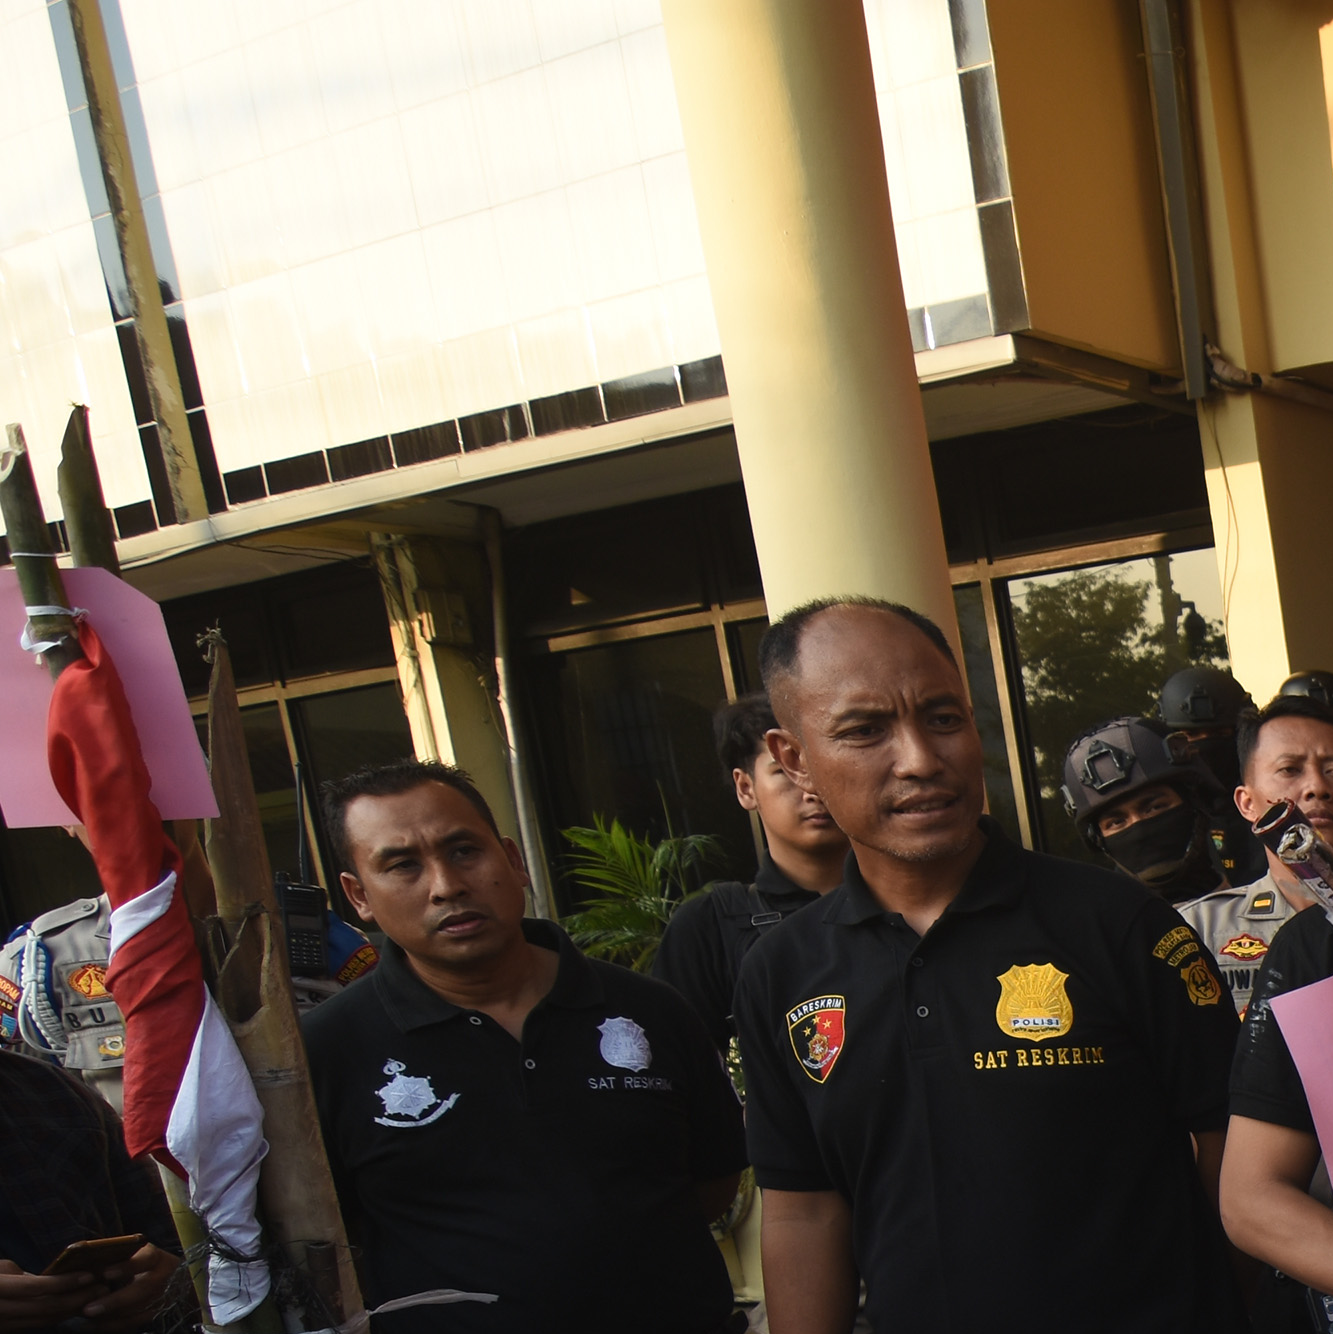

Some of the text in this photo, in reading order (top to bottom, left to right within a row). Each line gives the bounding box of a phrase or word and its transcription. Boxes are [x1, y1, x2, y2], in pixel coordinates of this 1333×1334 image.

[790, 998, 842, 1022] BARESKRIM
[1012, 1018, 1060, 1026] POLISI
[974, 1046, 1104, 1070] SAT RESKRIM
[588, 1077, 616, 1090] SAT
